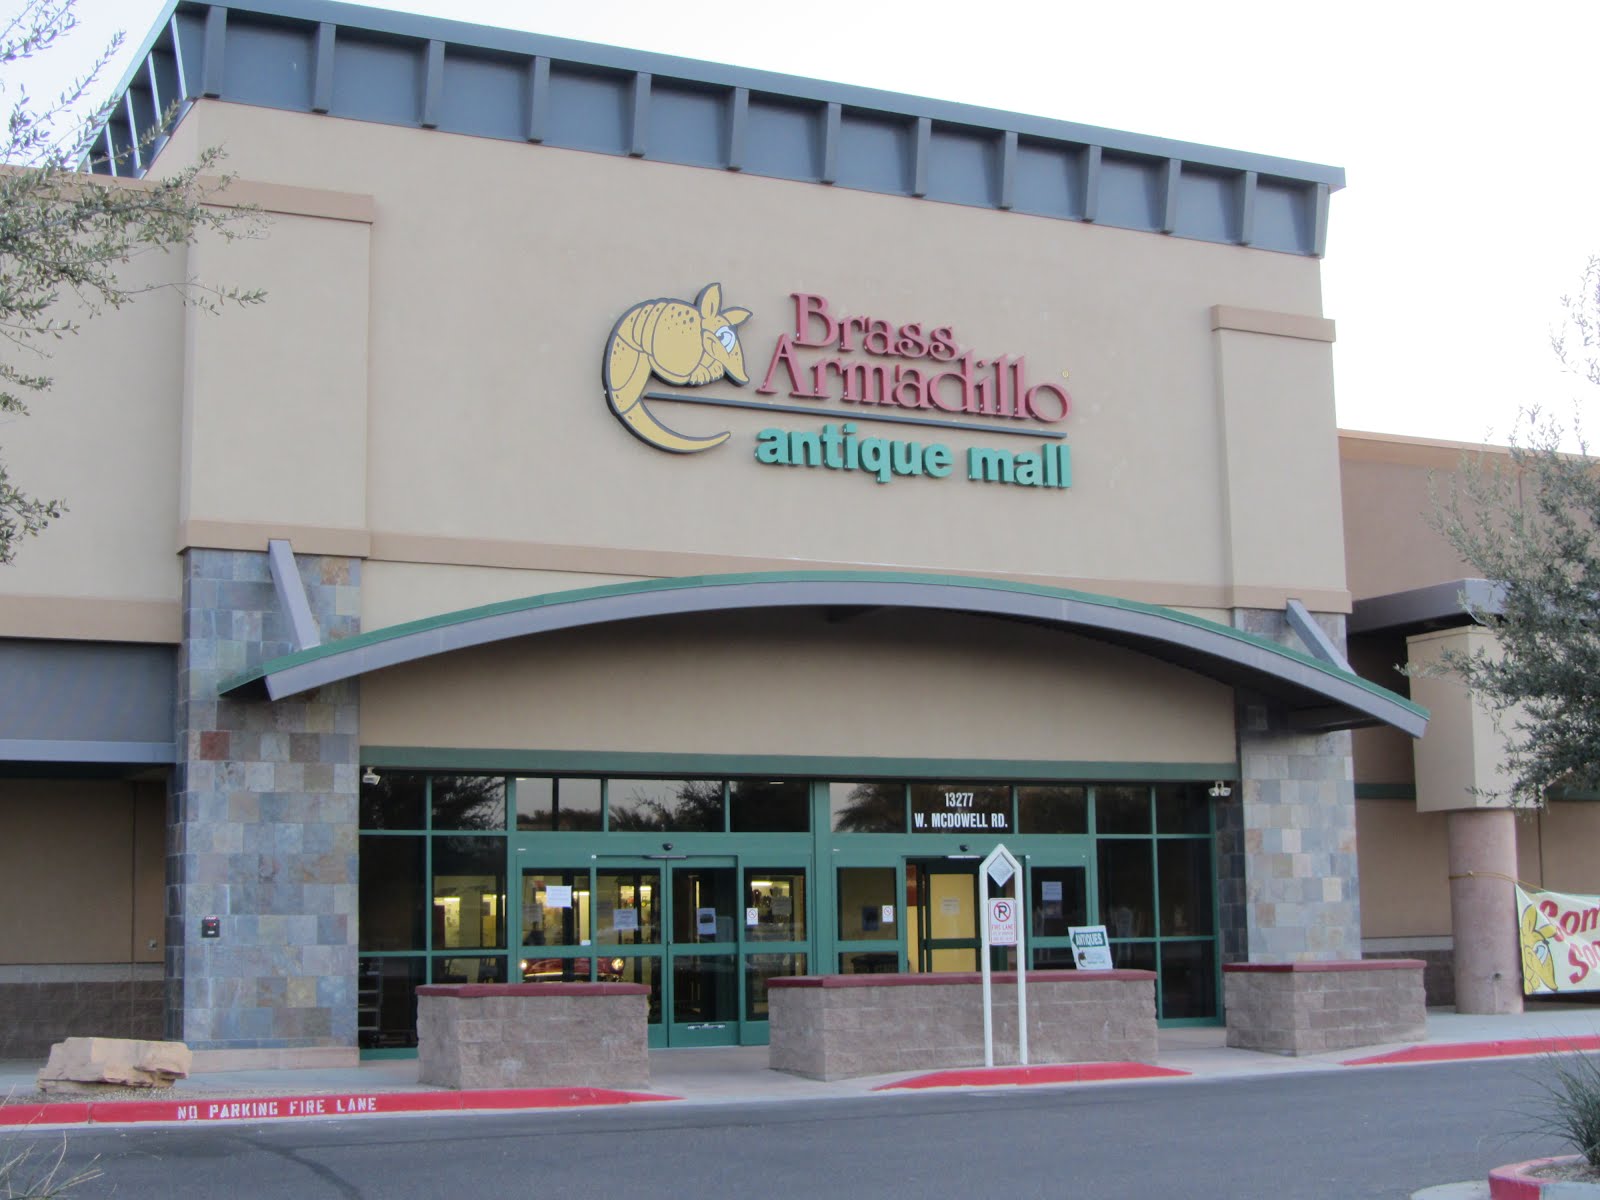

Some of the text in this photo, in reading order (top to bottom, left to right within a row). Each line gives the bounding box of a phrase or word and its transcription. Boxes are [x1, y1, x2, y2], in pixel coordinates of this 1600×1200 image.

[790, 292, 958, 361] Brass
[756, 333, 1072, 422] Armadillo
[755, 423, 1072, 488] antique mall
[944, 792, 974, 807] 13277
[914, 812, 1008, 828] W. MCDOWELL RD.
[1075, 932, 1104, 946] ANTIQUES
[177, 1097, 377, 1120] NO PARKING FIRE LANE
